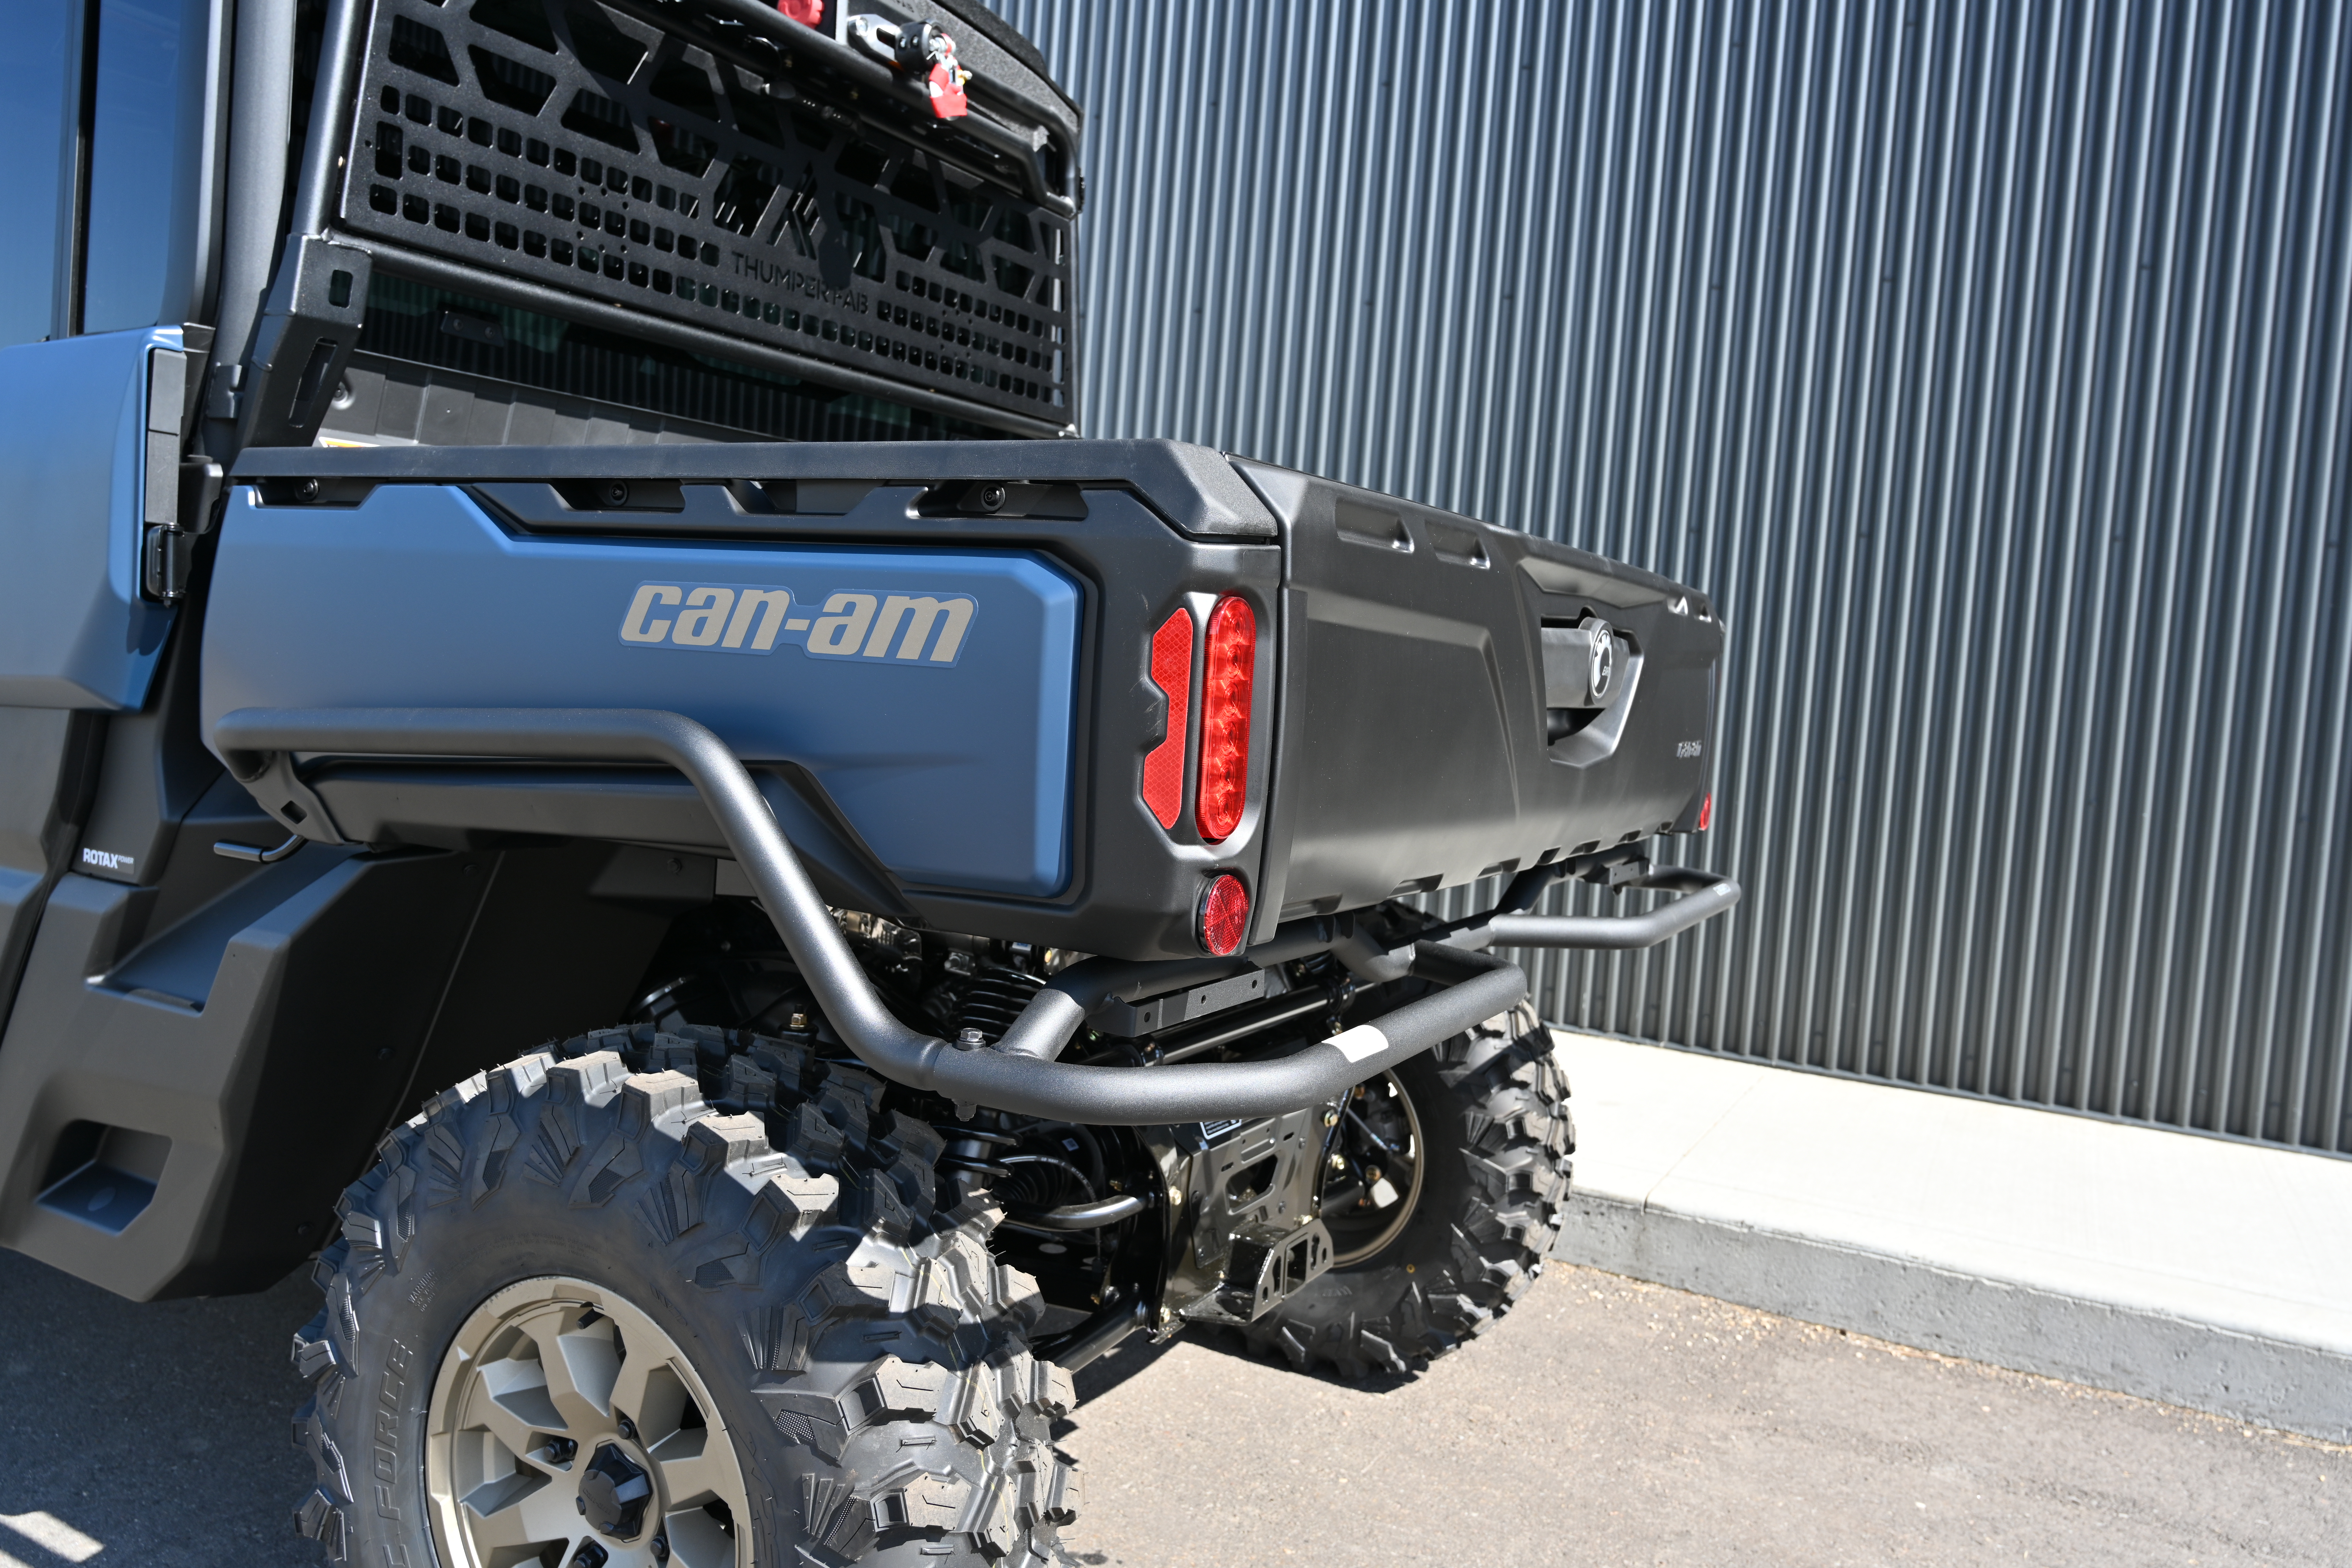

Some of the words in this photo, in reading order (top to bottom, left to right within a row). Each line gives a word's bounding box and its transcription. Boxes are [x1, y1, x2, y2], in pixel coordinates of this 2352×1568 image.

[621, 585, 974, 662] can-am
[83, 848, 118, 869] ROTAX
[118, 855, 134, 864] POWER
[375, 1339, 413, 1520] FORCE
